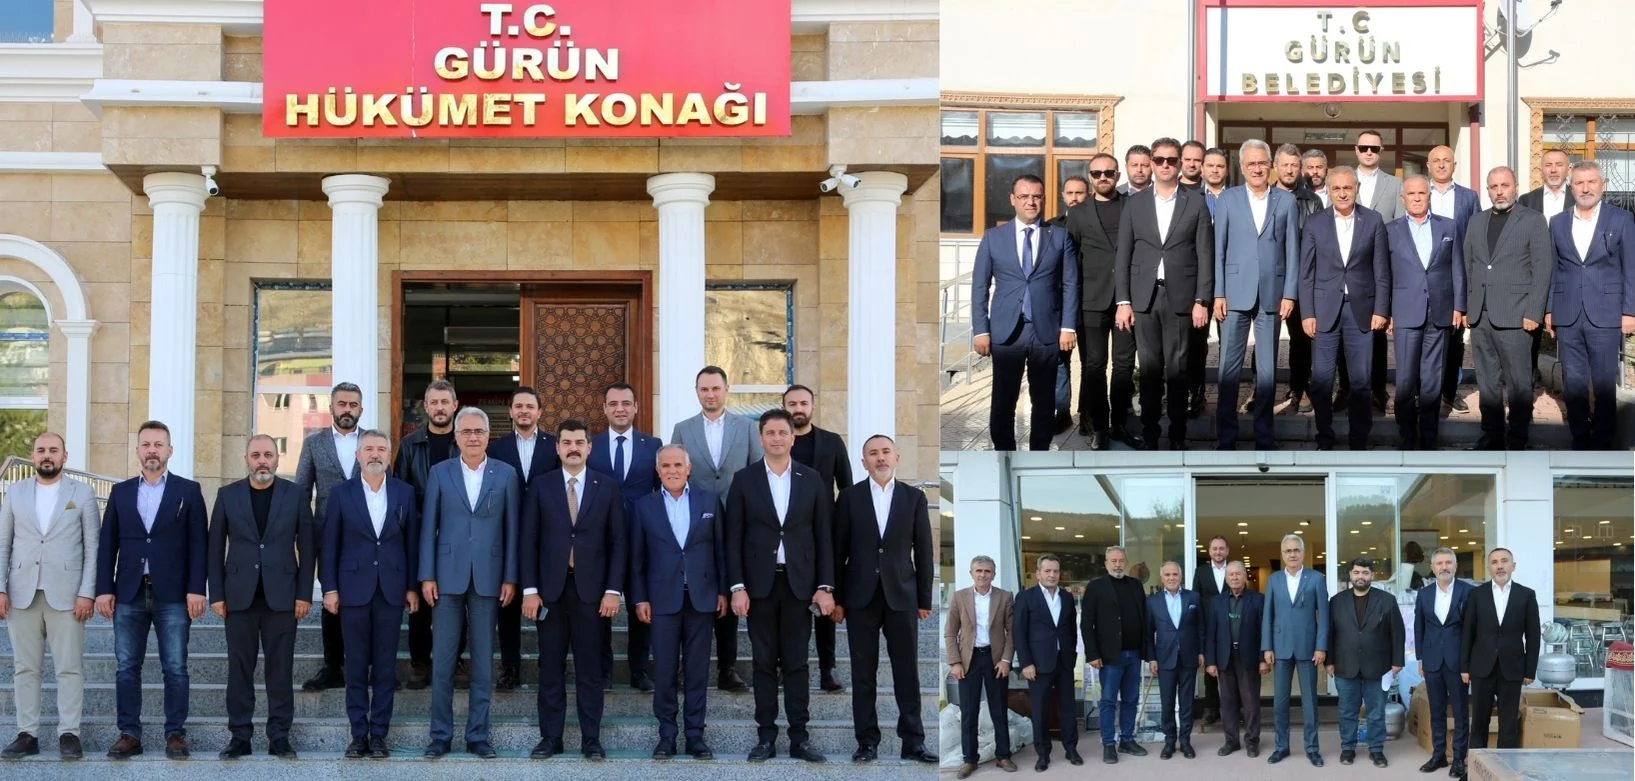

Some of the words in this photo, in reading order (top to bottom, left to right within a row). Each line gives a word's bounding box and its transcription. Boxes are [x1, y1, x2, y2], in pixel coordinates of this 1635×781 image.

[481, 3, 571, 37] T.C.
[433, 40, 619, 81] GÜRÜN
[1284, 35, 1400, 64] GÜRÜN
[1241, 66, 1441, 95] BELEDİYESİ
[285, 86, 546, 127] HÜKÜMET
[564, 82, 767, 127] KONAĞI
